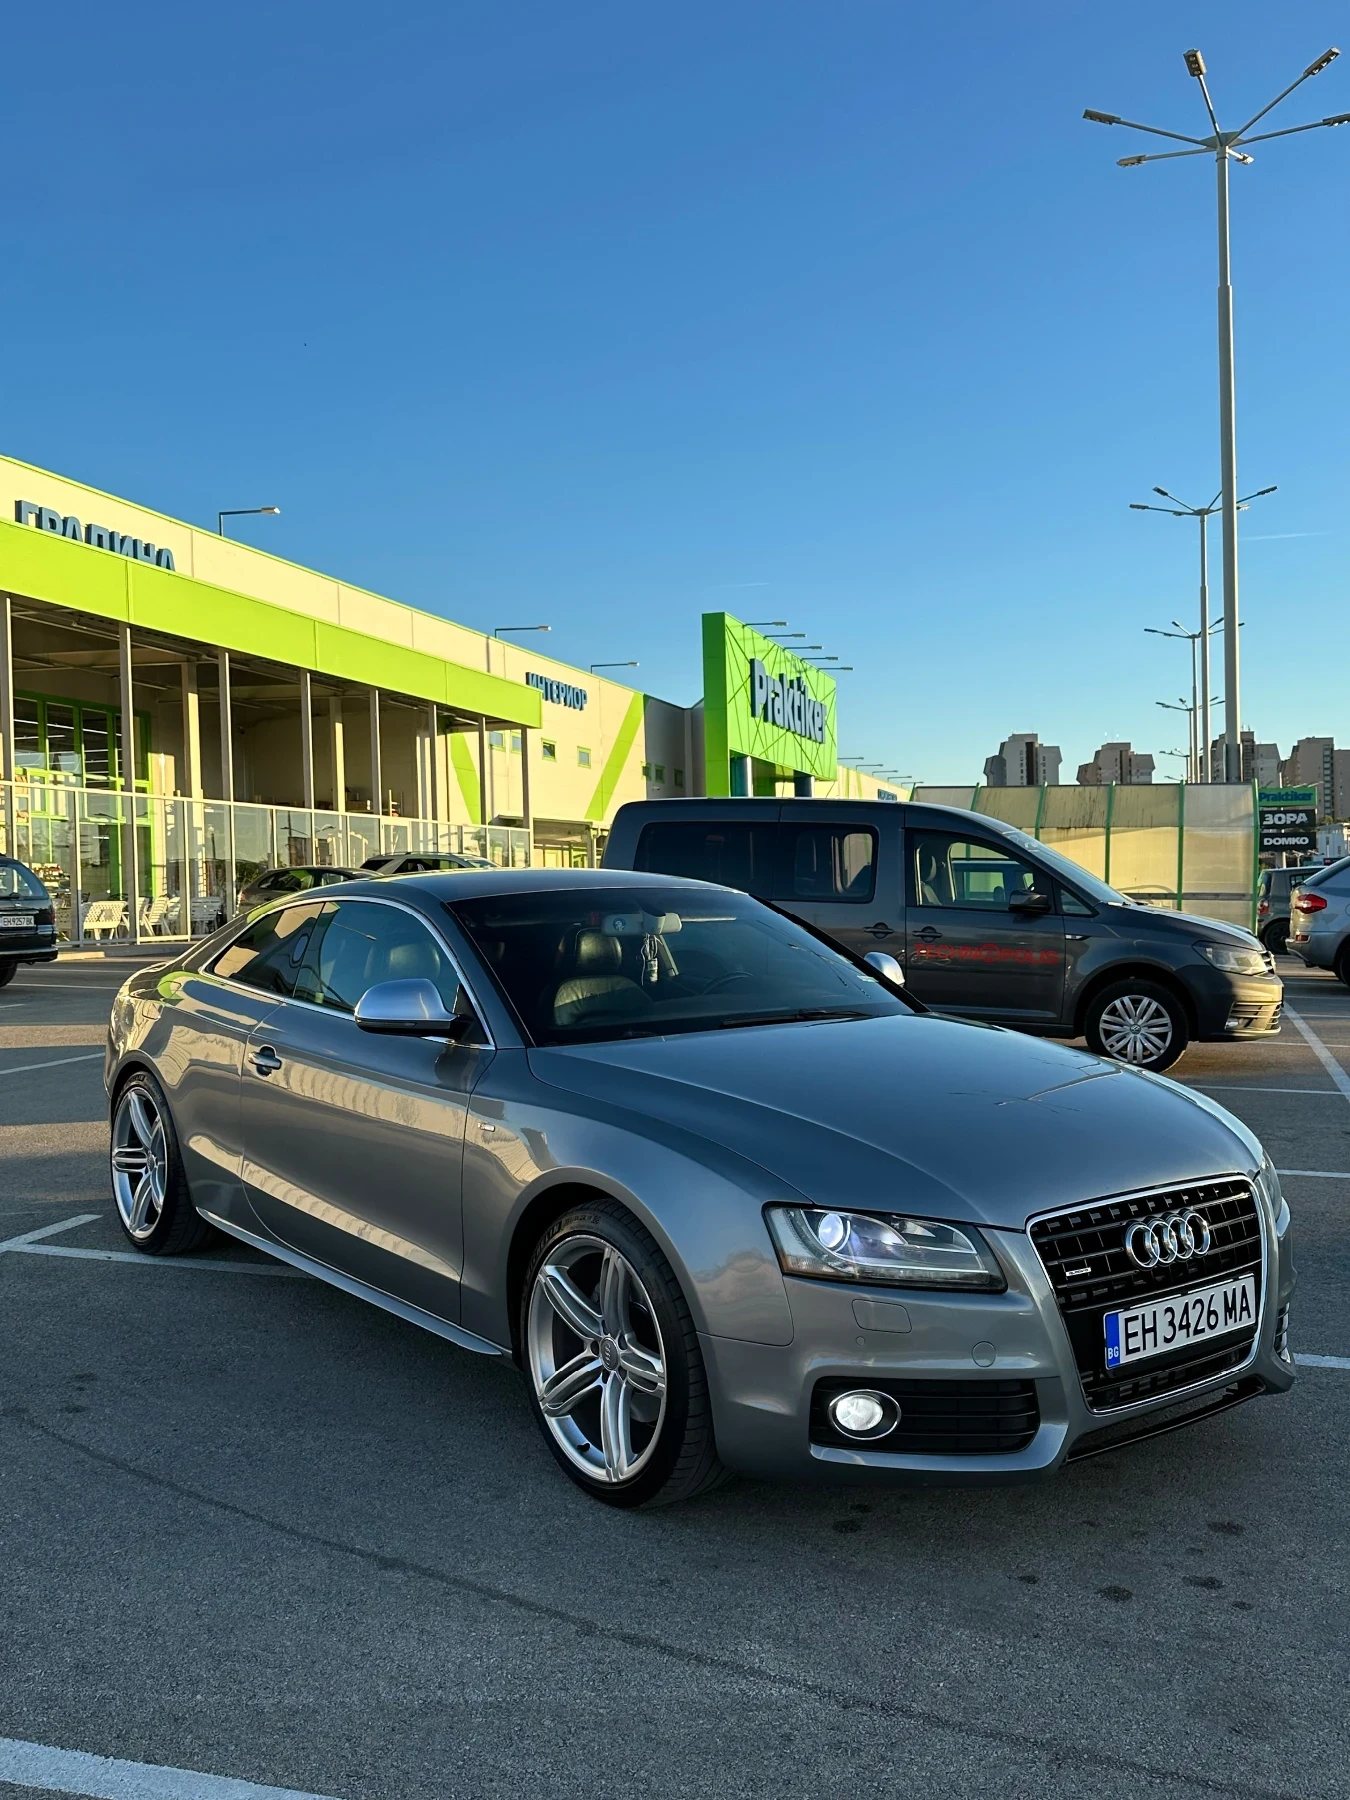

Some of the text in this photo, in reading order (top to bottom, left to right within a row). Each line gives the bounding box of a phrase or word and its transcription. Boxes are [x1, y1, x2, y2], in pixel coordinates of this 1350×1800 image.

[750, 658, 827, 744] Praktiker
[1258, 791, 1313, 802] Praktiker
[1263, 837, 1309, 846] DOMKO
[913, 943, 1059, 965] TECHNOPOLIS
[1124, 1285, 1251, 1356] EH 3426 MA
[1107, 1346, 1119, 1360] BG
